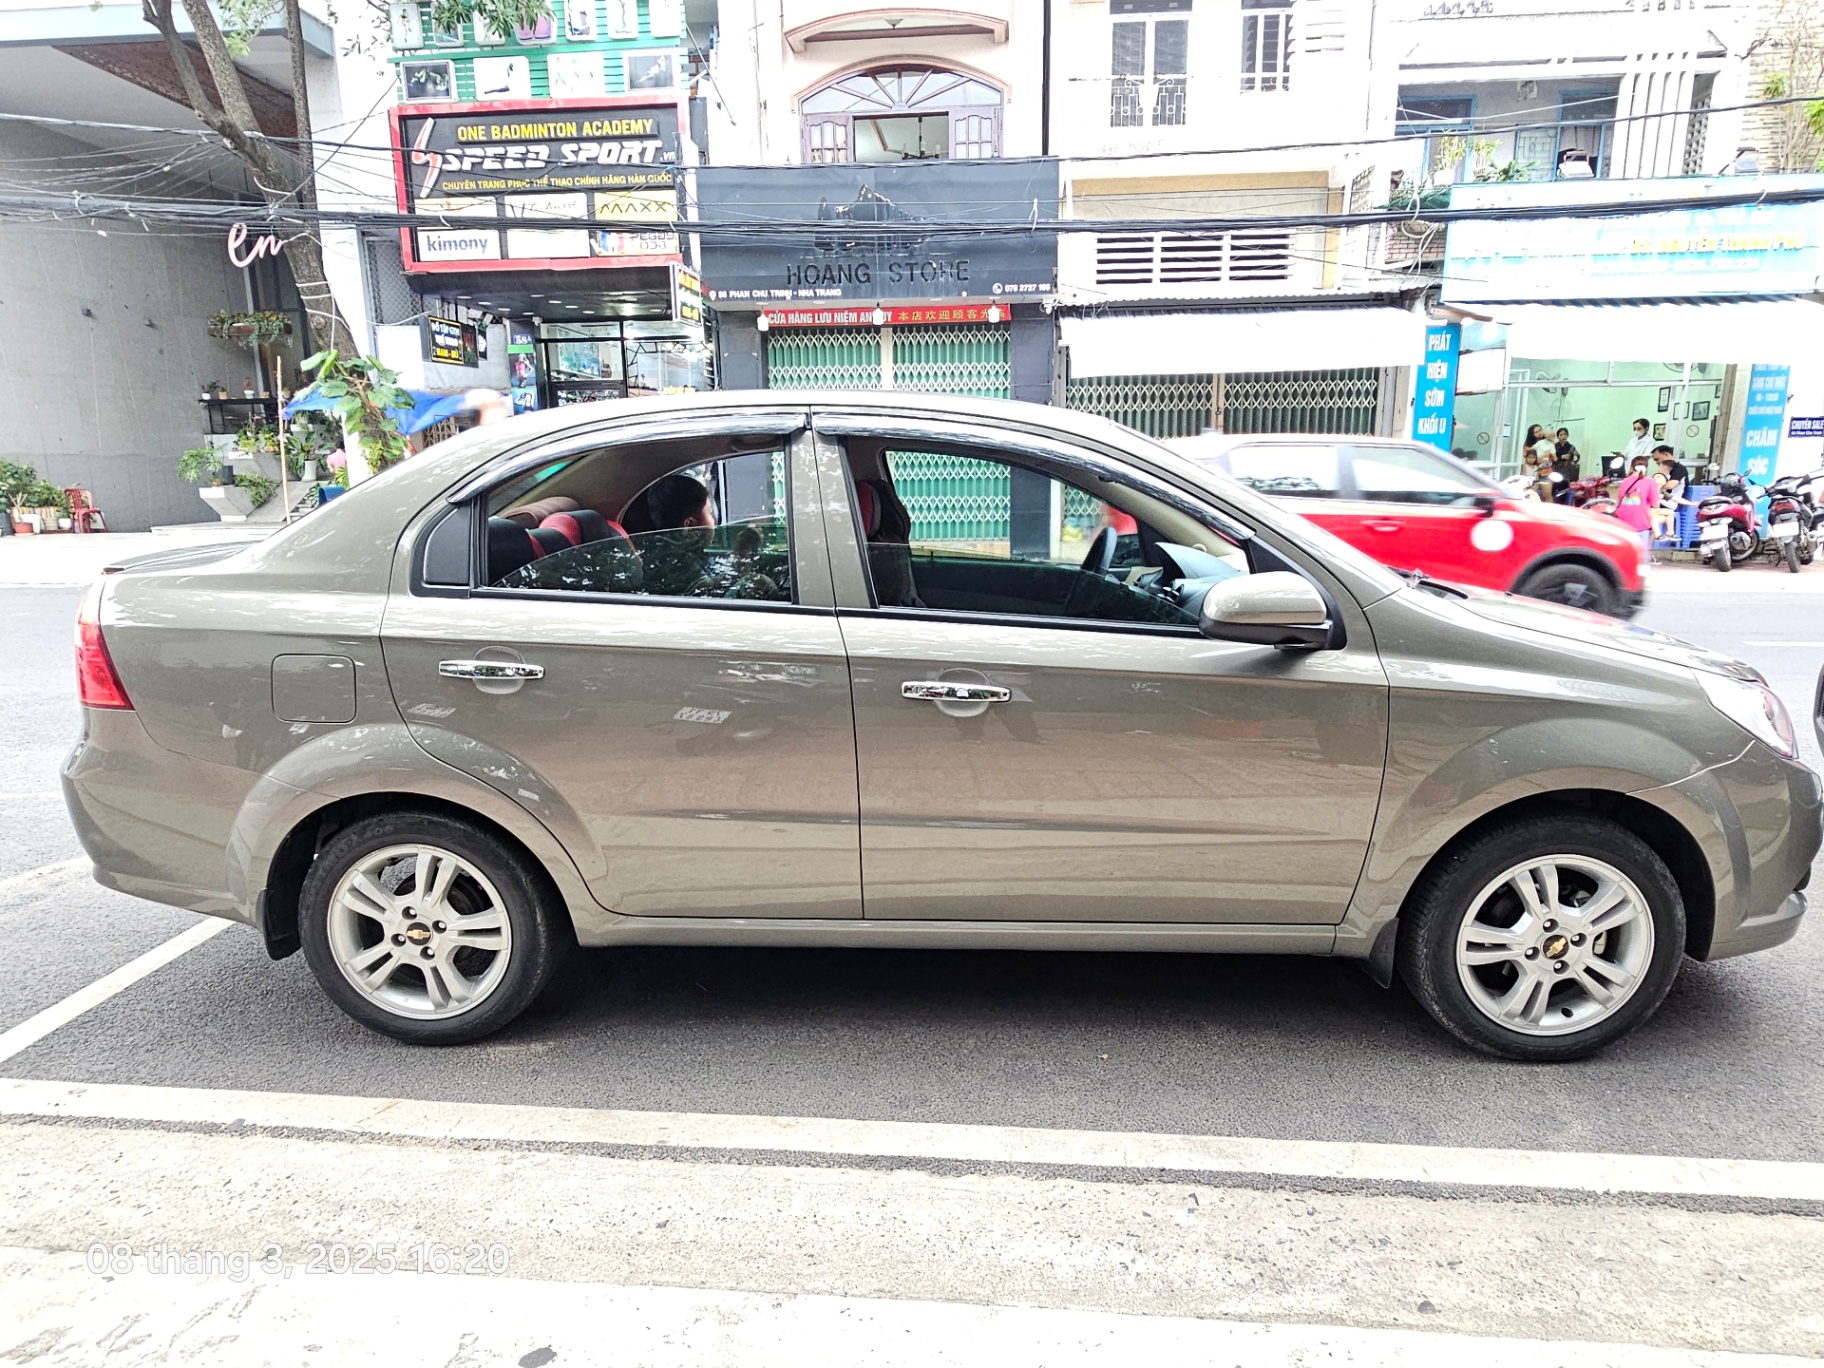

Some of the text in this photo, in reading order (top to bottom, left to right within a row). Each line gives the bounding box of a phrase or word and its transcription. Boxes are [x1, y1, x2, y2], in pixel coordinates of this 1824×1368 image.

[457, 118, 654, 141] ONE BADMINTON ACADEMY
[442, 144, 549, 171] SPEED
[560, 140, 663, 167] SPORT
[442, 179, 476, 190] CHUYÊN
[478, 179, 506, 189] TRANG
[550, 177, 573, 187] THAO
[574, 174, 600, 186] CHÍNH
[628, 174, 646, 183] HÀN
[426, 234, 488, 254] kimony
[786, 260, 970, 286] HOANG STORE
[729, 290, 750, 298] PHAN
[752, 289, 769, 298] CHU
[769, 289, 793, 298] TRINH
[798, 289, 814, 297] NHA
[815, 288, 842, 297] TRANG
[768, 311, 786, 325] CỬA
[788, 311, 812, 324] HÀNG
[834, 310, 858, 325] NIỆM
[1428, 330, 1451, 351] PHÁT
[1426, 358, 1448, 383] HIỆN
[1424, 386, 1446, 408] SỚM
[1417, 412, 1447, 435] KHỐI U
[1745, 426, 1778, 447] CHĂM
[1747, 454, 1769, 475] SÓC
